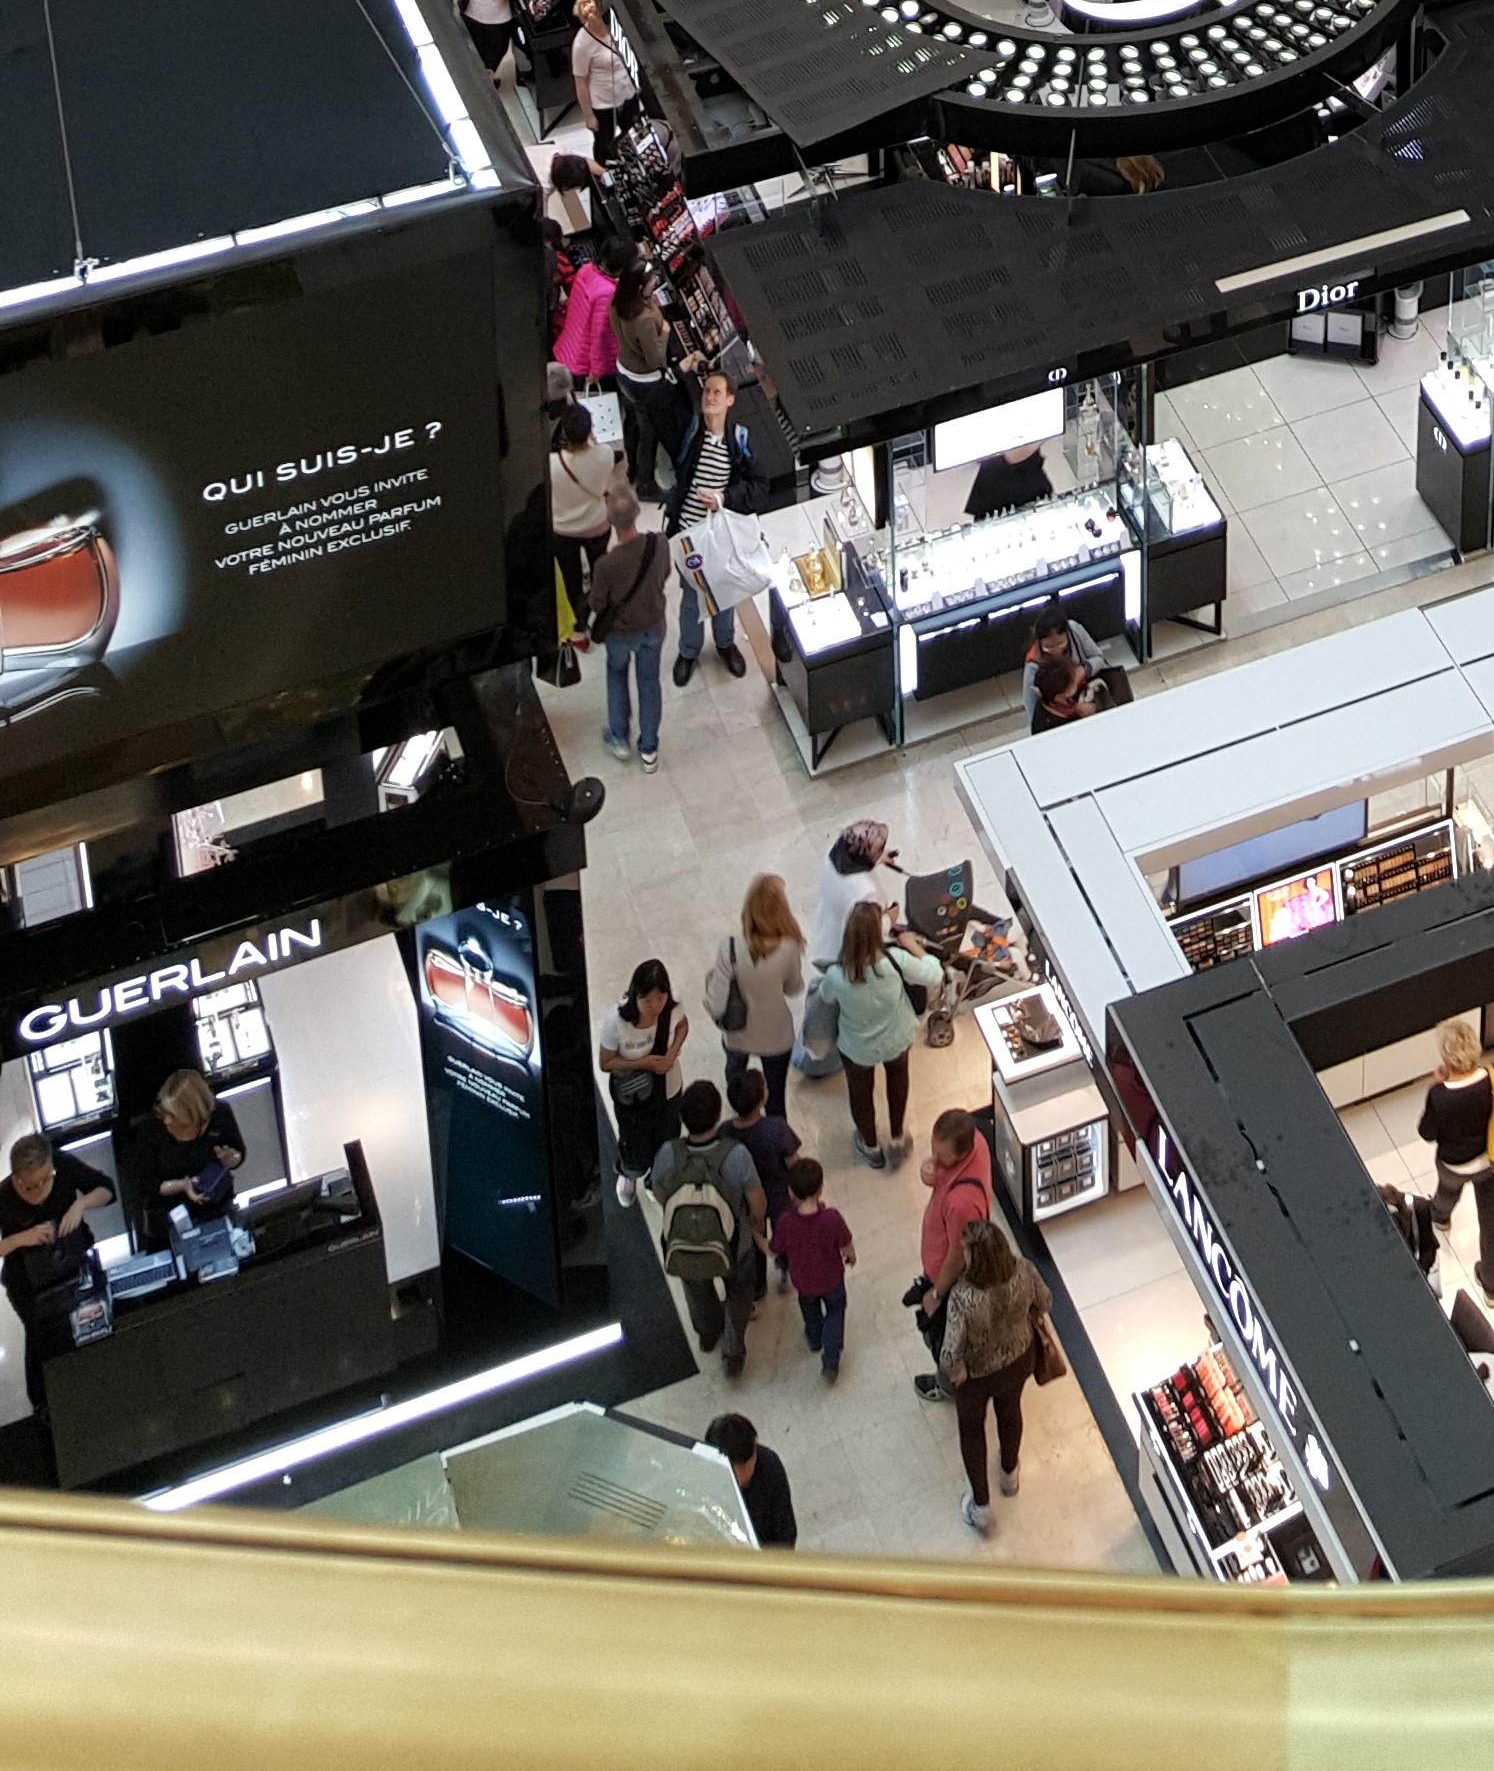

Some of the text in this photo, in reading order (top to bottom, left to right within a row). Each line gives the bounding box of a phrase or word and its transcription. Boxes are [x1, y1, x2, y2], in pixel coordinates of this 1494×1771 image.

[1296, 281, 1359, 314] Dior
[203, 421, 443, 501] QUI SUIS-JE ?
[214, 495, 442, 570] VOTRE NOUVEAU PARFUM
[224, 468, 430, 535] GUERLAIN VOUS INVITE
[295, 499, 378, 531] NOMMER
[249, 545, 323, 576] FÉMININ
[18, 918, 322, 1040] GUERLAIN
[1157, 1124, 1298, 1437] LANCÔME
